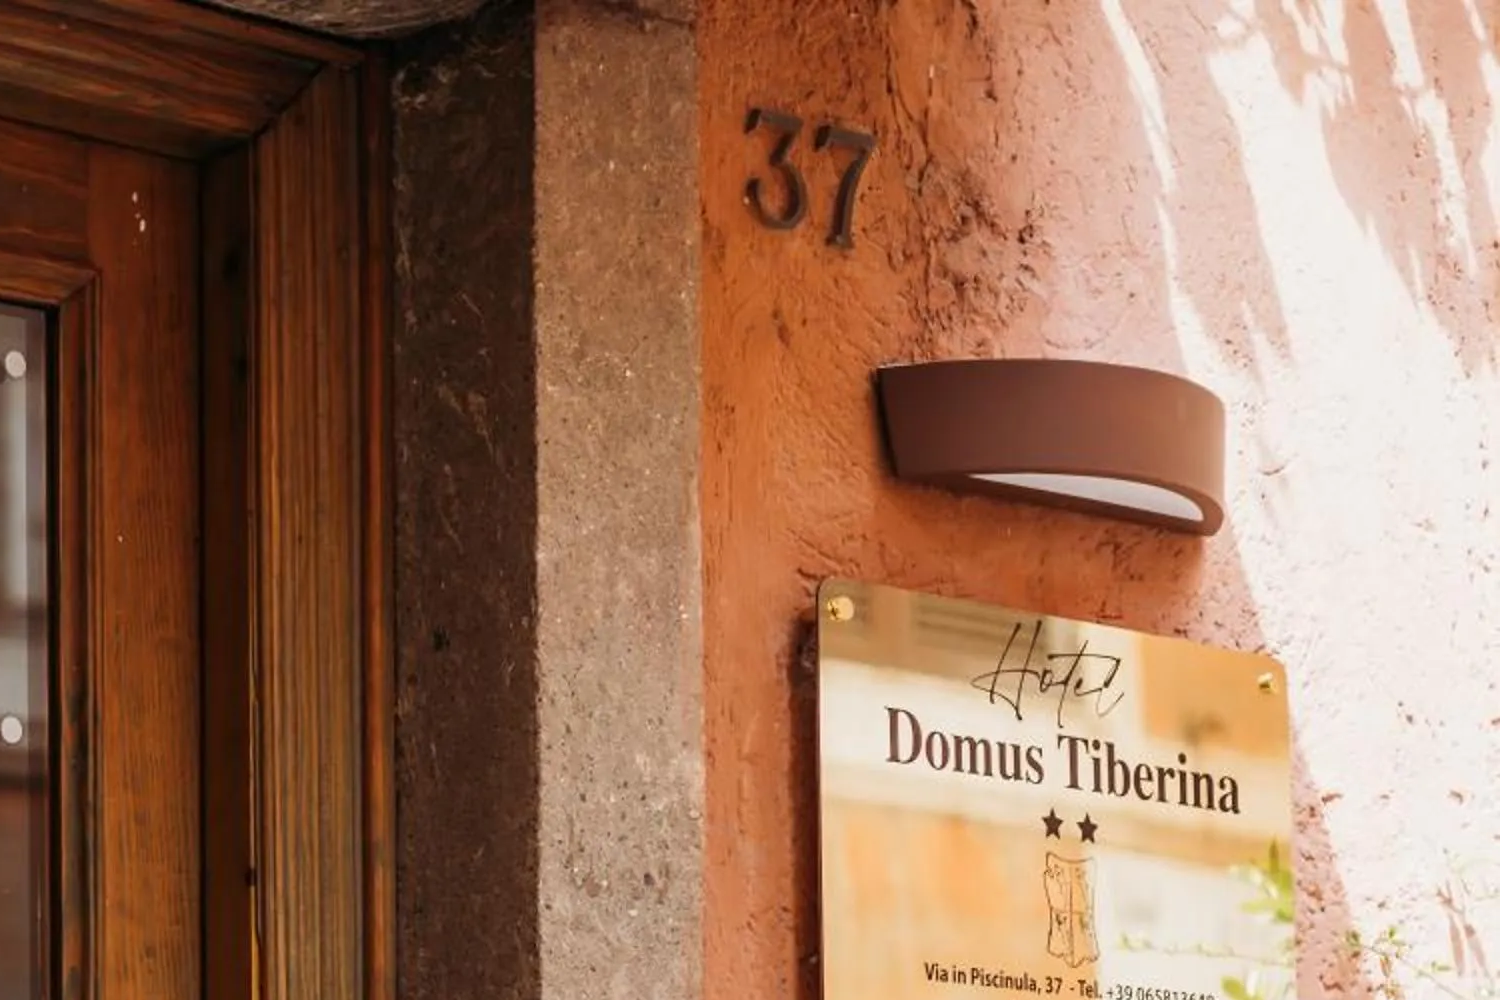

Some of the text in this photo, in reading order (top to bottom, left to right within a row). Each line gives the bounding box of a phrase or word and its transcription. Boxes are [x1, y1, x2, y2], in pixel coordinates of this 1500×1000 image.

[744, 108, 877, 250] 37
[970, 619, 1125, 728] Hotel
[884, 704, 1242, 815] Domus Tiberina
[924, 962, 949, 983] Via
[951, 965, 967, 985] in
[970, 967, 1042, 995] Piscinula,
[1045, 976, 1063, 995] 37
[1077, 979, 1103, 999] Tel.
